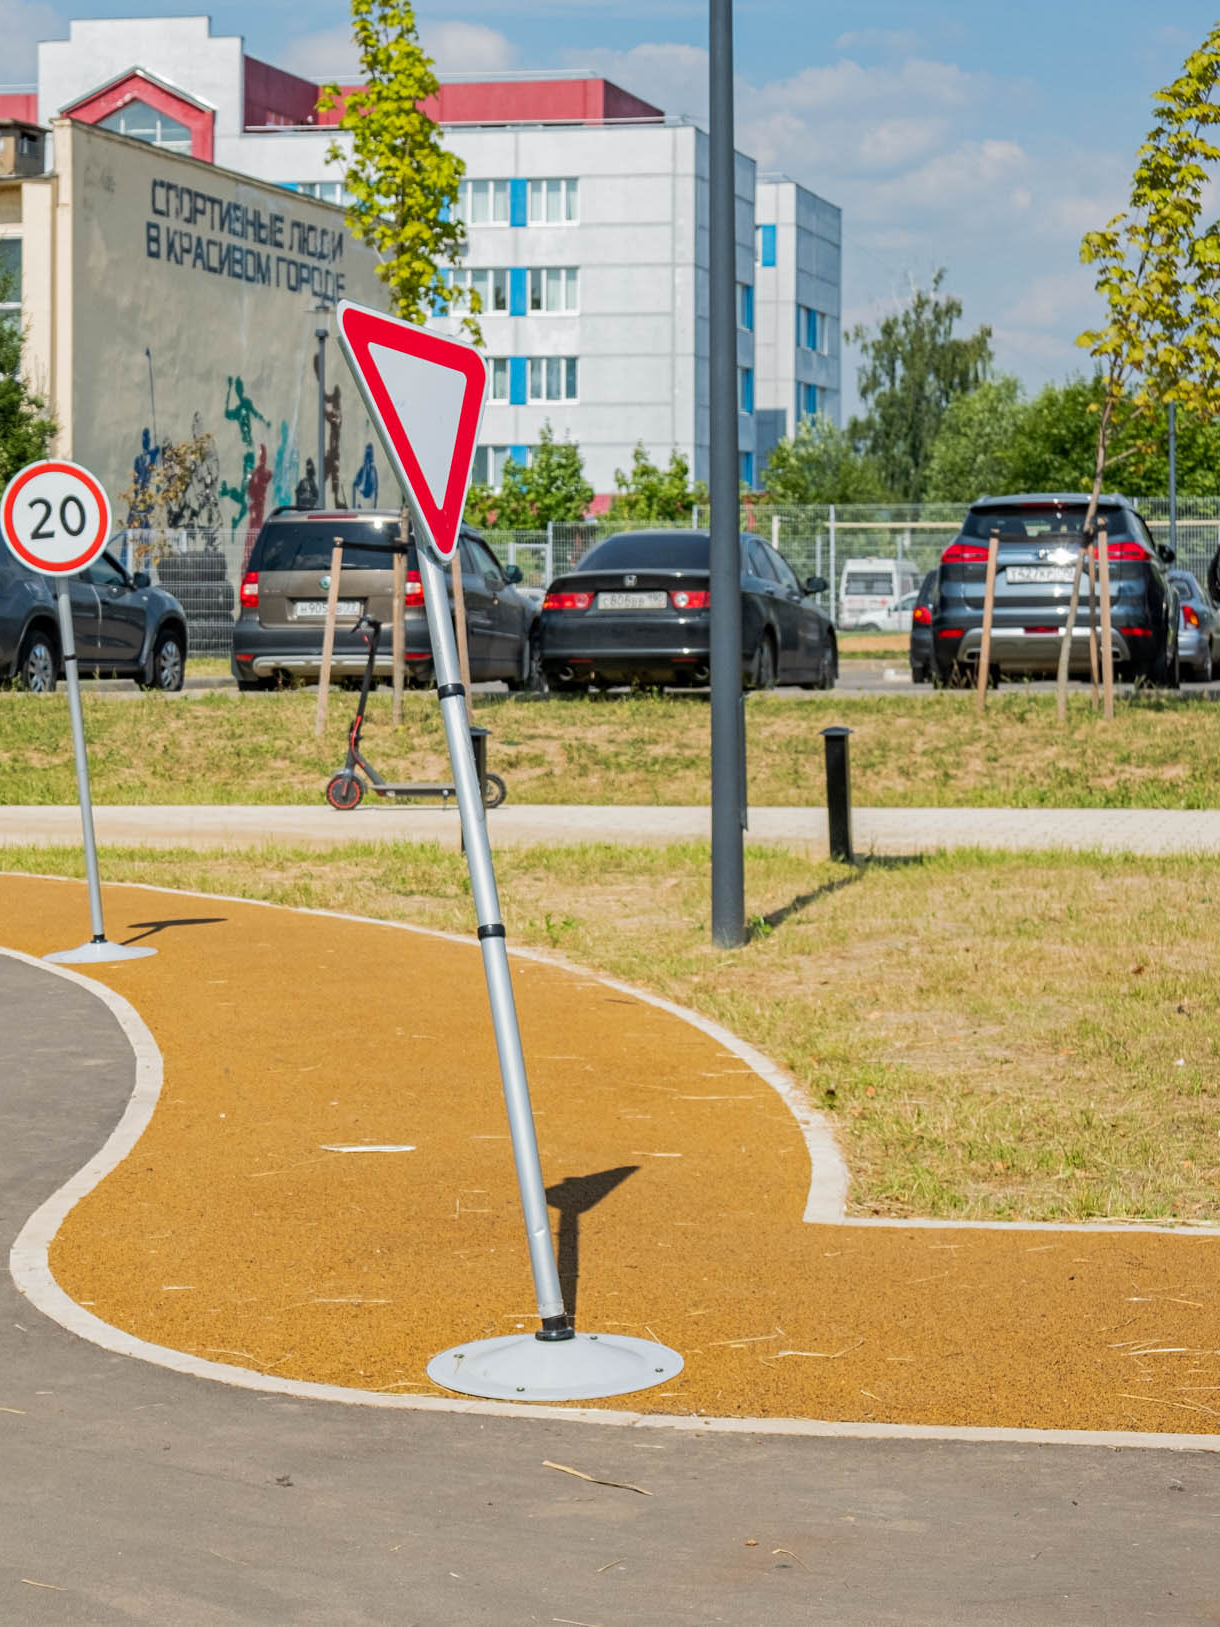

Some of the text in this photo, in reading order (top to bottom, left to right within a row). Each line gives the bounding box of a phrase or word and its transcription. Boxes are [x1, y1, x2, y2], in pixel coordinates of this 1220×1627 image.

[146, 220, 346, 304] В КРАСИВОМ ГОРОДЕ
[151, 178, 344, 264] СПОРТИВНЫЕ ЛЮДИ
[28, 495, 86, 540] 20
